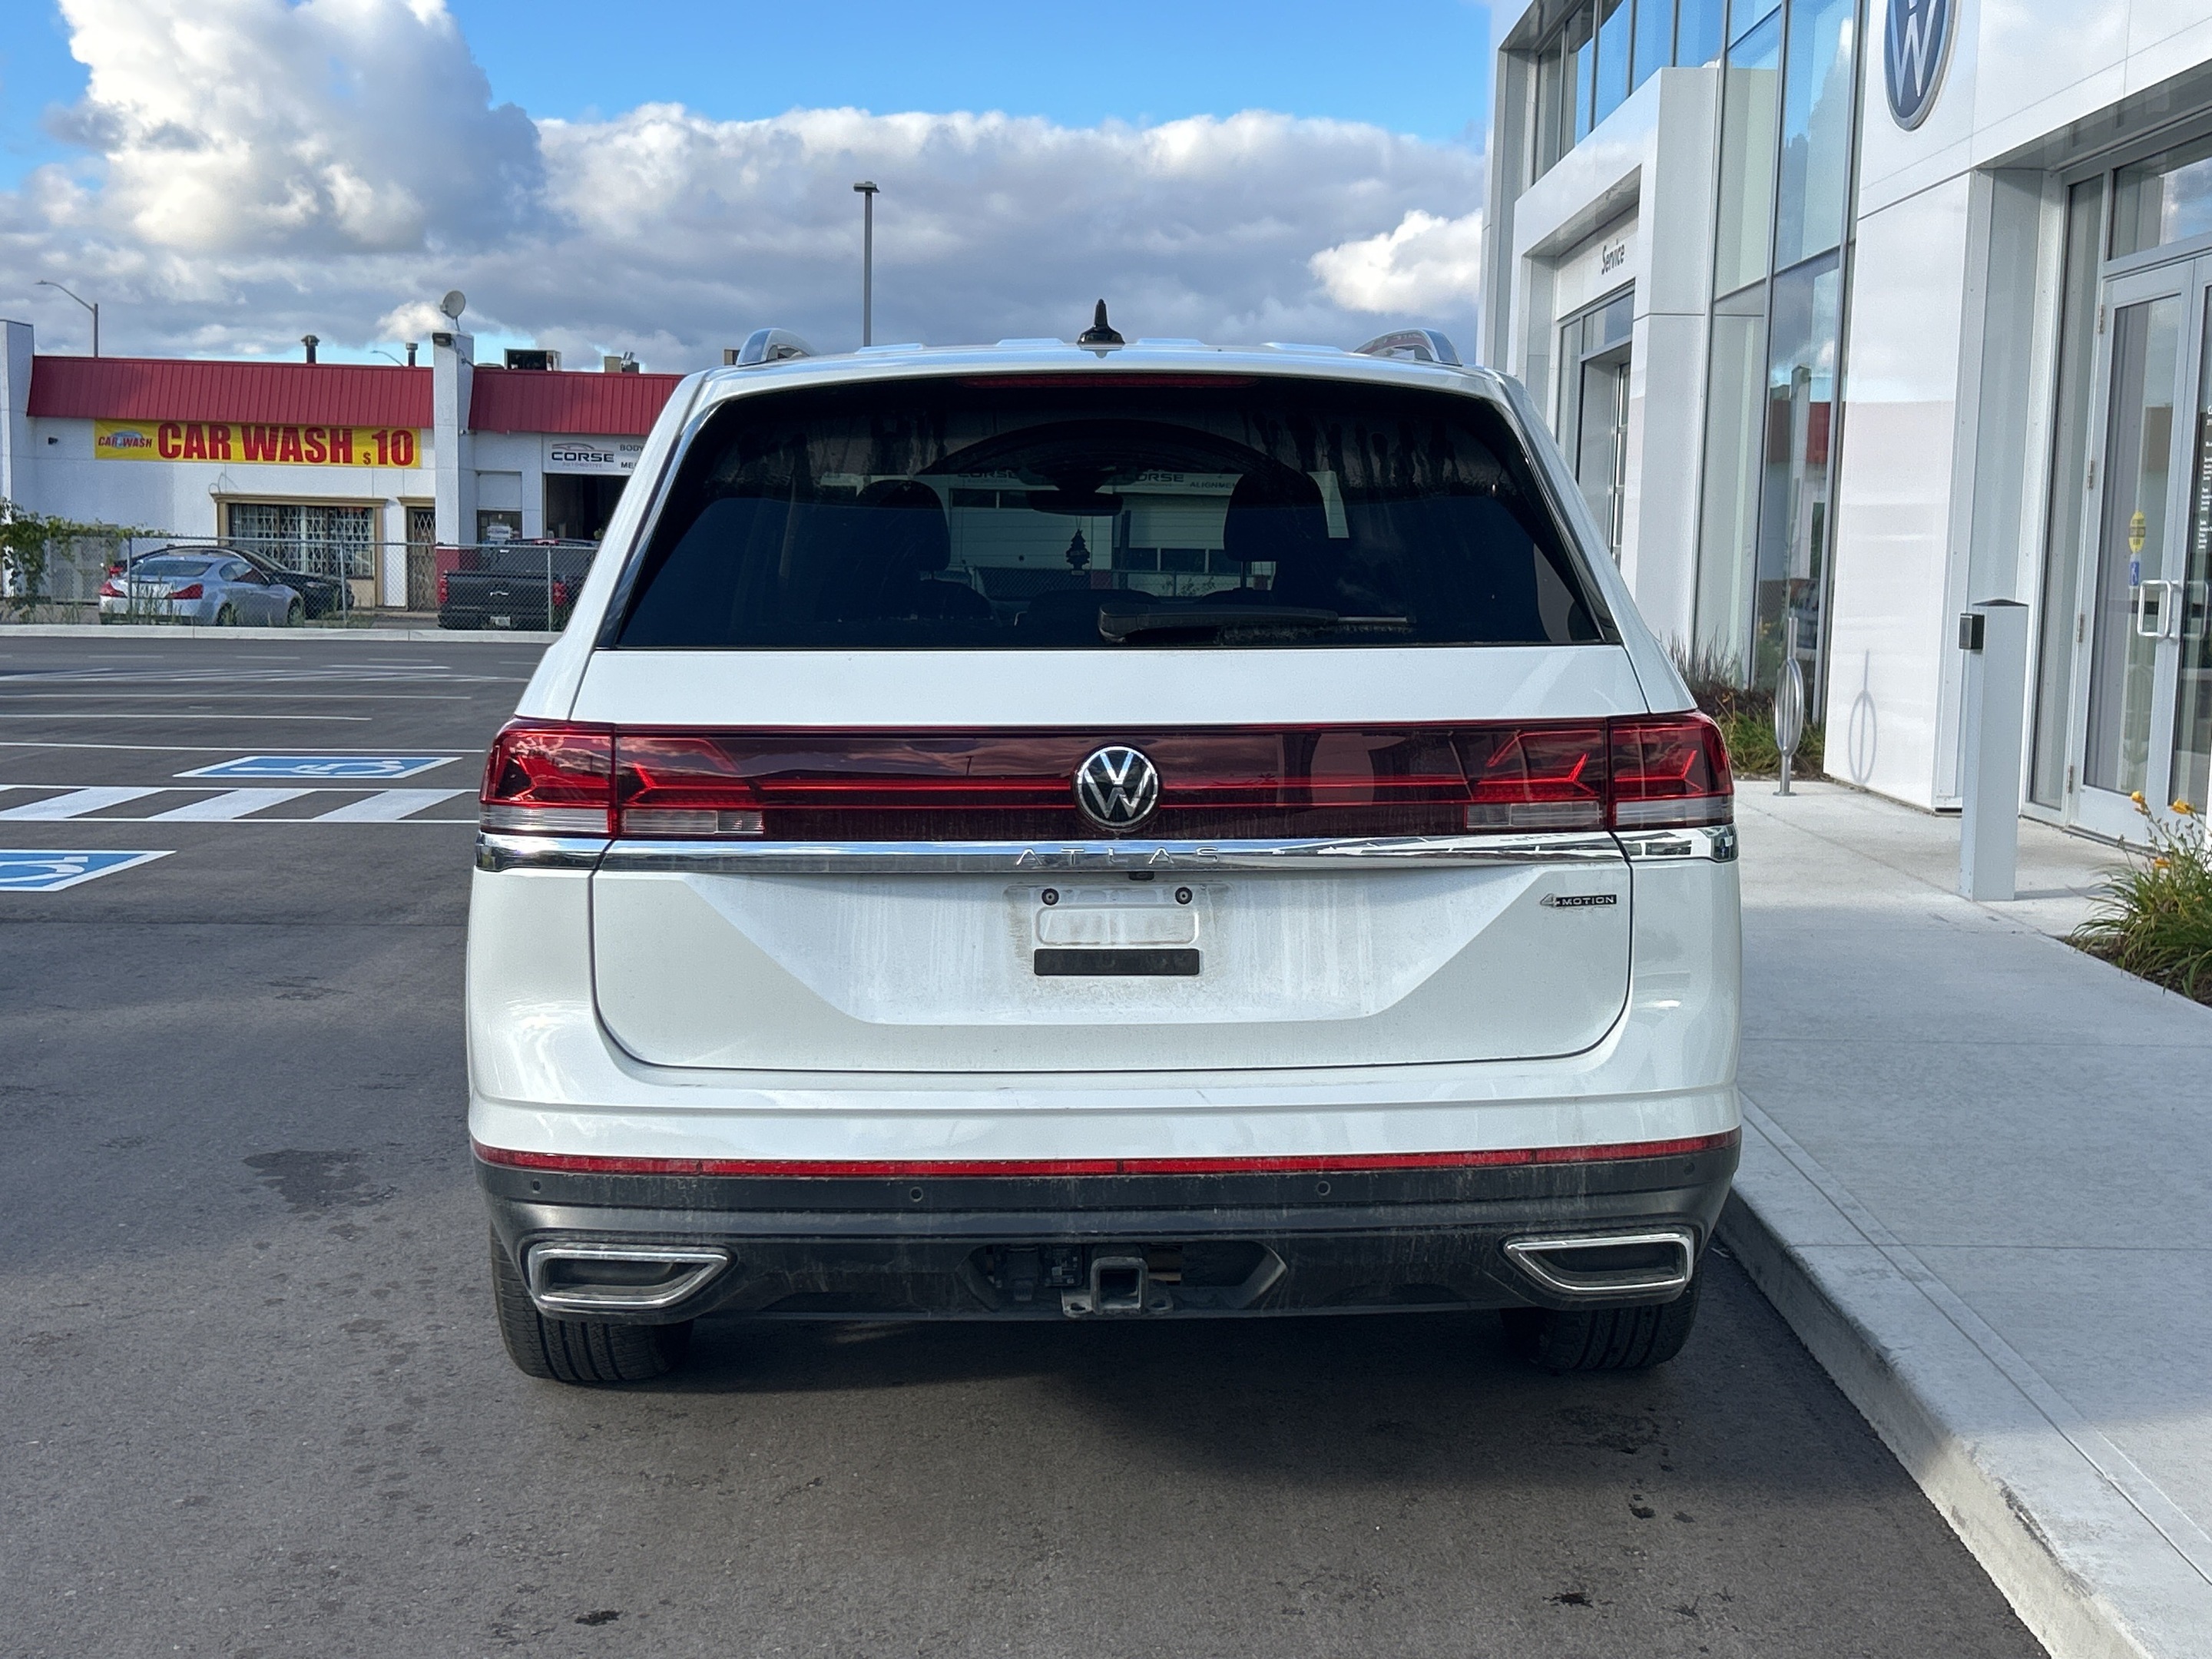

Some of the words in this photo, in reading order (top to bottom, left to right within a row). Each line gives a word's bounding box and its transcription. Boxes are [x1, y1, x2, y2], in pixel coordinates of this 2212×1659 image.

[1601, 238, 1624, 275] Service
[98, 436, 118, 446] CAR
[122, 438, 153, 448] WASH
[158, 422, 231, 459] CAR
[240, 426, 353, 464] WASH
[551, 452, 614, 462] CORSE
[1015, 846, 1219, 866] ATLAS
[1540, 893, 1617, 907] 4MOTION
